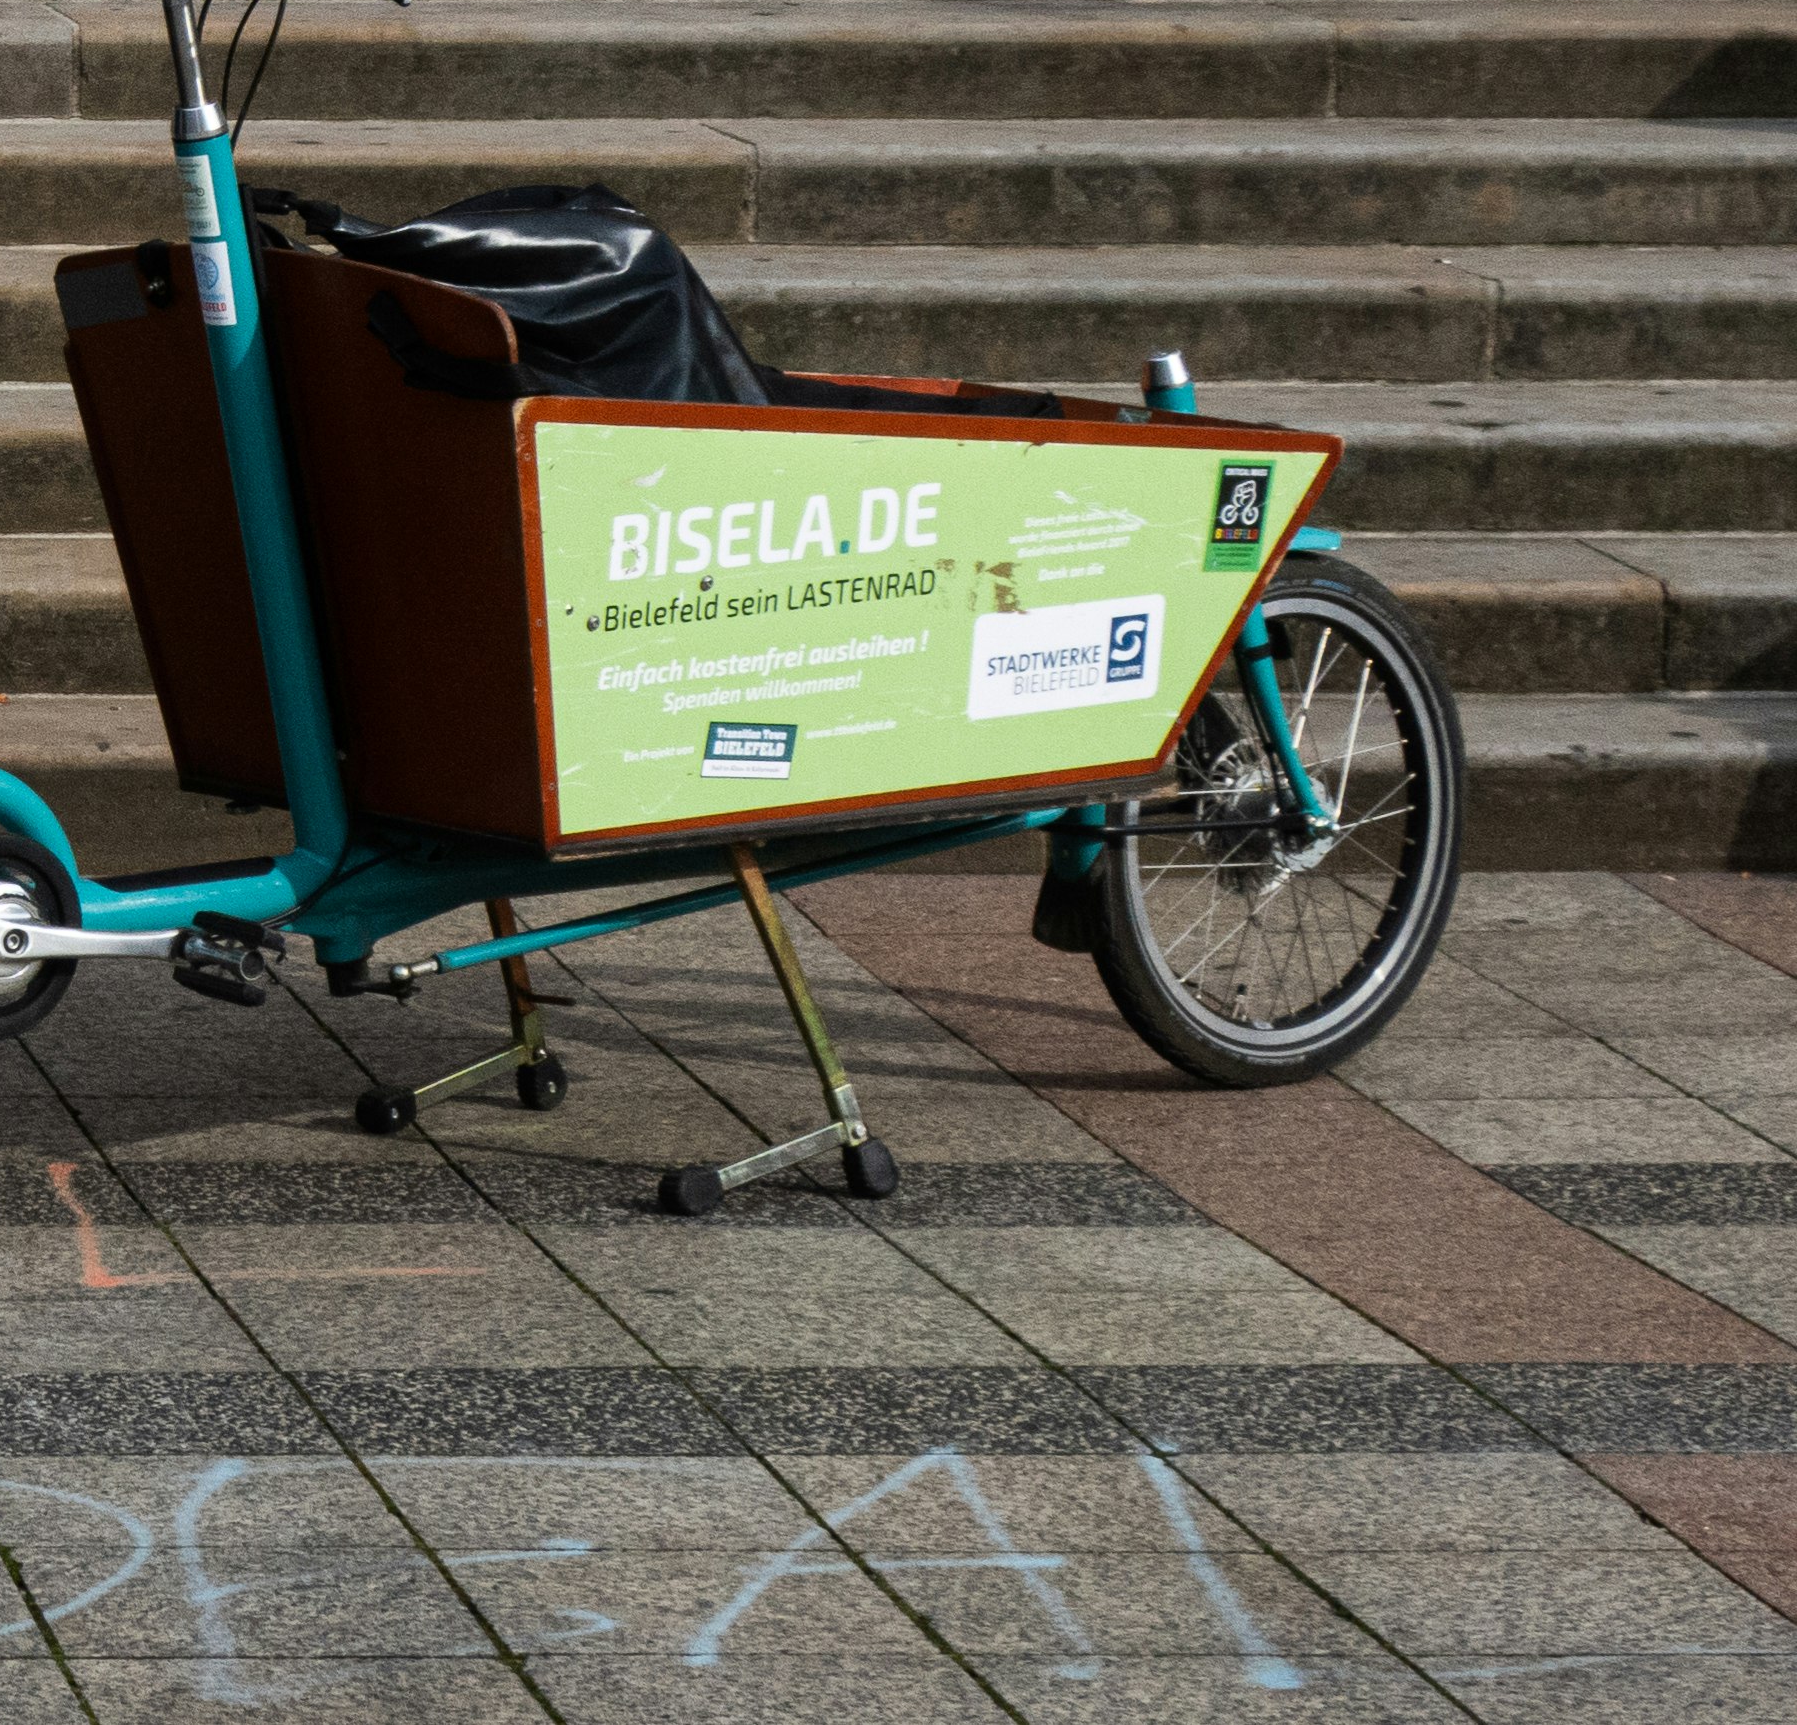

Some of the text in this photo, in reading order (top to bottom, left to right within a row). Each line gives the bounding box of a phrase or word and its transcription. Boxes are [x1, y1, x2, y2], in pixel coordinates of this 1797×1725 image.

[609, 483, 942, 581] BISELA.DE
[604, 569, 937, 632] Bielefeld sein LASTENRAD
[597, 659, 684, 693] Einfach
[688, 643, 806, 680] kostenfrei
[809, 634, 917, 665] ausleihen
[987, 645, 1102, 676] STADTWERKE
[1109, 665, 1143, 679] GRUPPE
[662, 669, 863, 715] Spenden willkommen!
[1013, 667, 1100, 696] BIELEFELD
[713, 740, 787, 757] BIELEFELD
[716, 727, 788, 741] Transition Town
